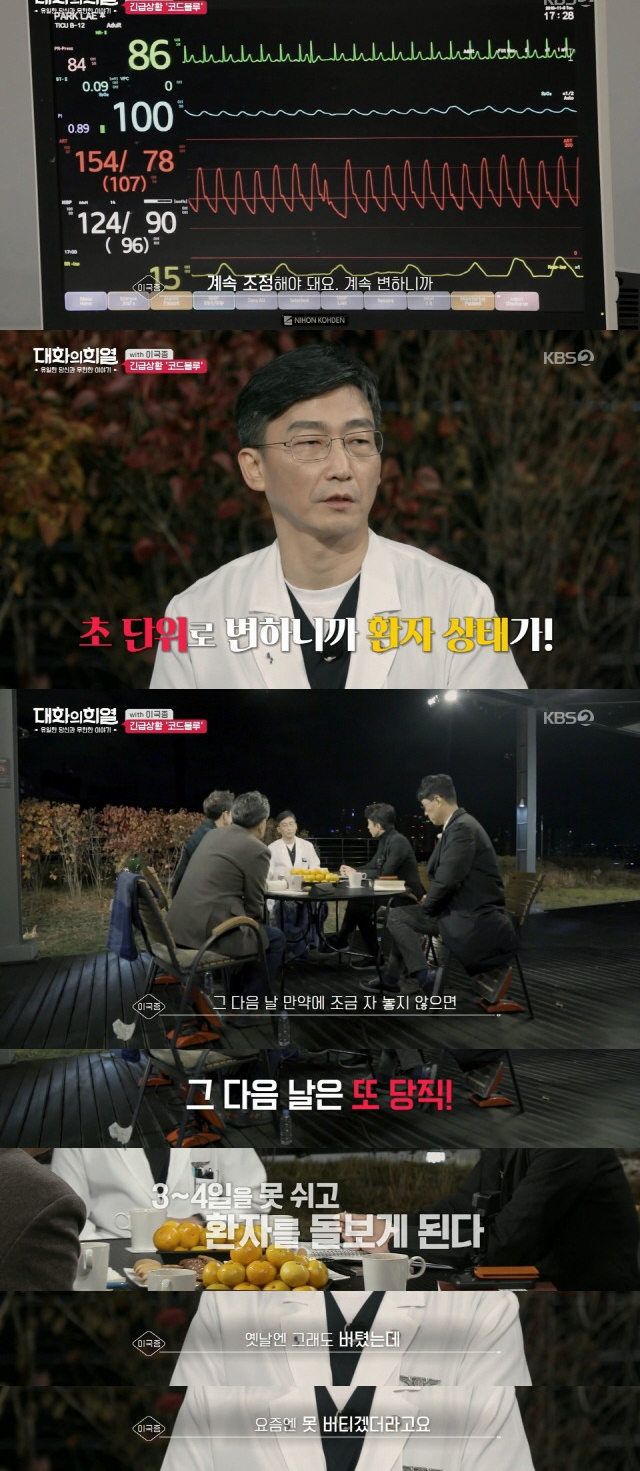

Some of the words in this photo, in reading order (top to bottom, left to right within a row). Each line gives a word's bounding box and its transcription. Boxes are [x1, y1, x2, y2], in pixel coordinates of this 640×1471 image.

[544, 12, 574, 20] 17:28
[128, 39, 171, 71] 86
[67, 57, 86, 72] 84
[82, 81, 109, 92] 0.09
[164, 81, 173, 91] 0
[113, 101, 174, 132] 100
[67, 124, 90, 134] 0.89
[143, 150, 174, 172] 78
[103, 175, 147, 193] (107)
[146, 211, 177, 234] 90
[150, 266, 181, 290] 15
[294, 316, 317, 324] NIHON
[317, 316, 346, 324] KOHDEN
